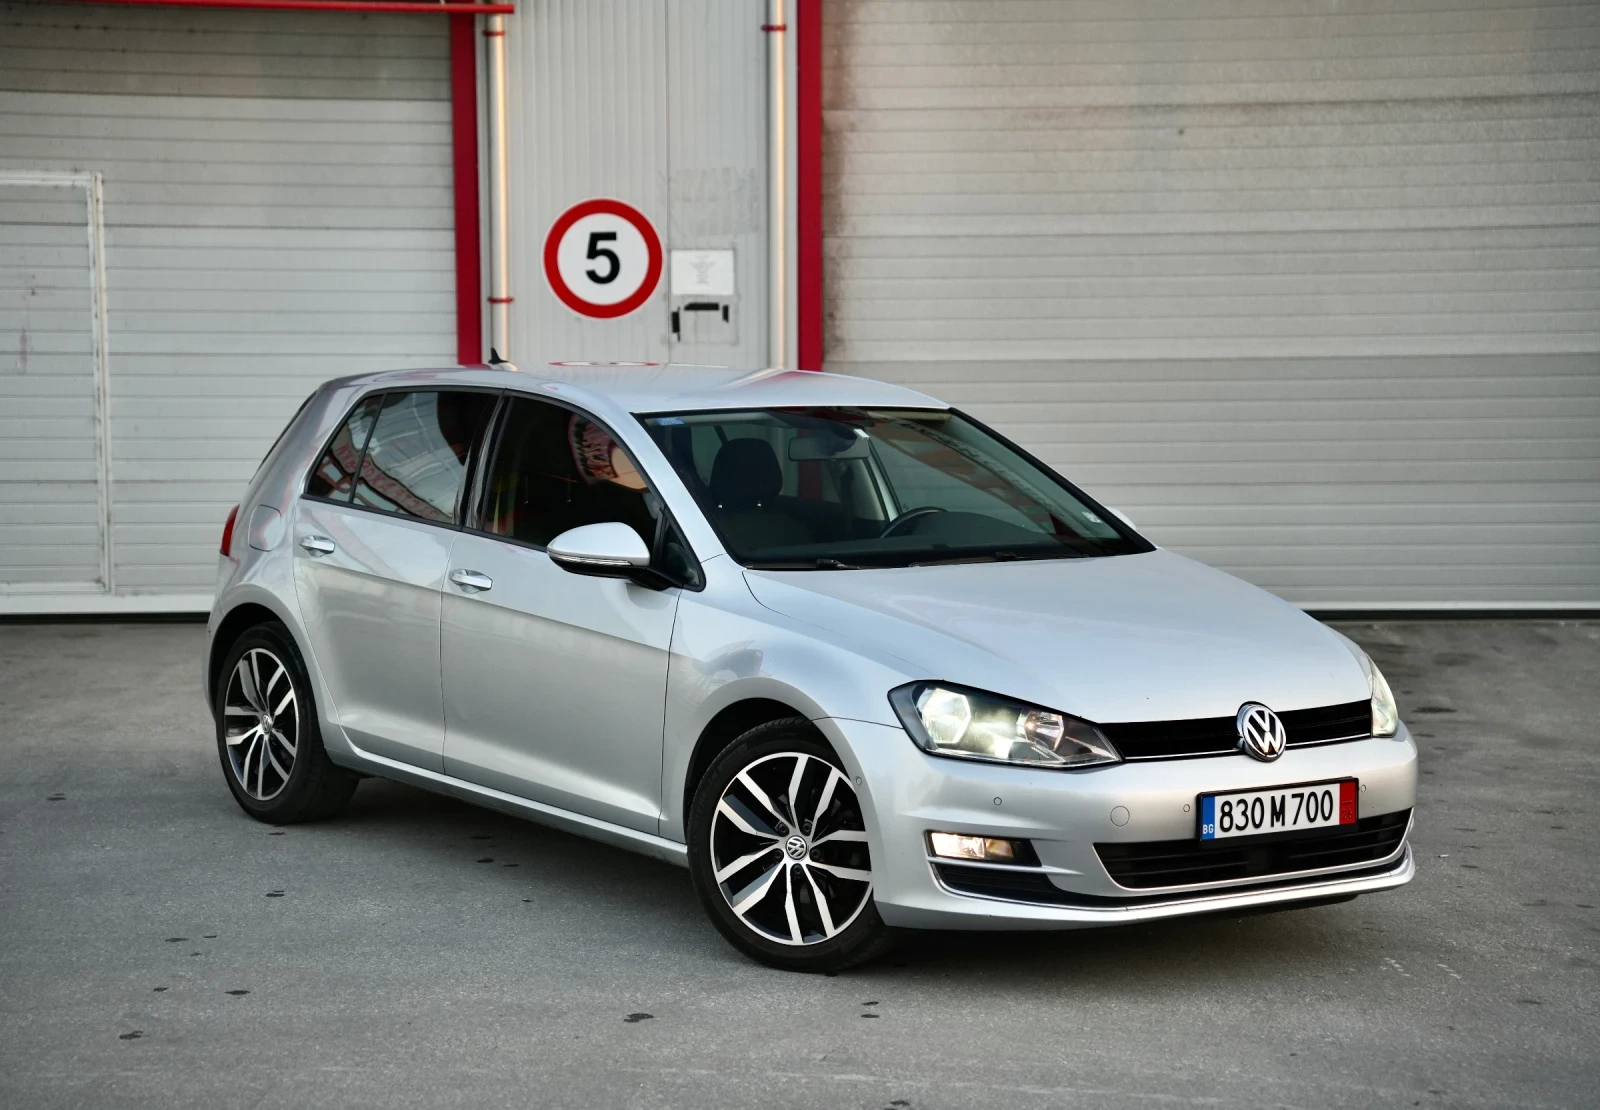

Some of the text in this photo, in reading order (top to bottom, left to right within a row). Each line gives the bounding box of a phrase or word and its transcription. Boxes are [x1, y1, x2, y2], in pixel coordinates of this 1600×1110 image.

[585, 231, 621, 285] 5
[1202, 823, 1214, 835] BG
[1219, 789, 1334, 833] 830 M 700
